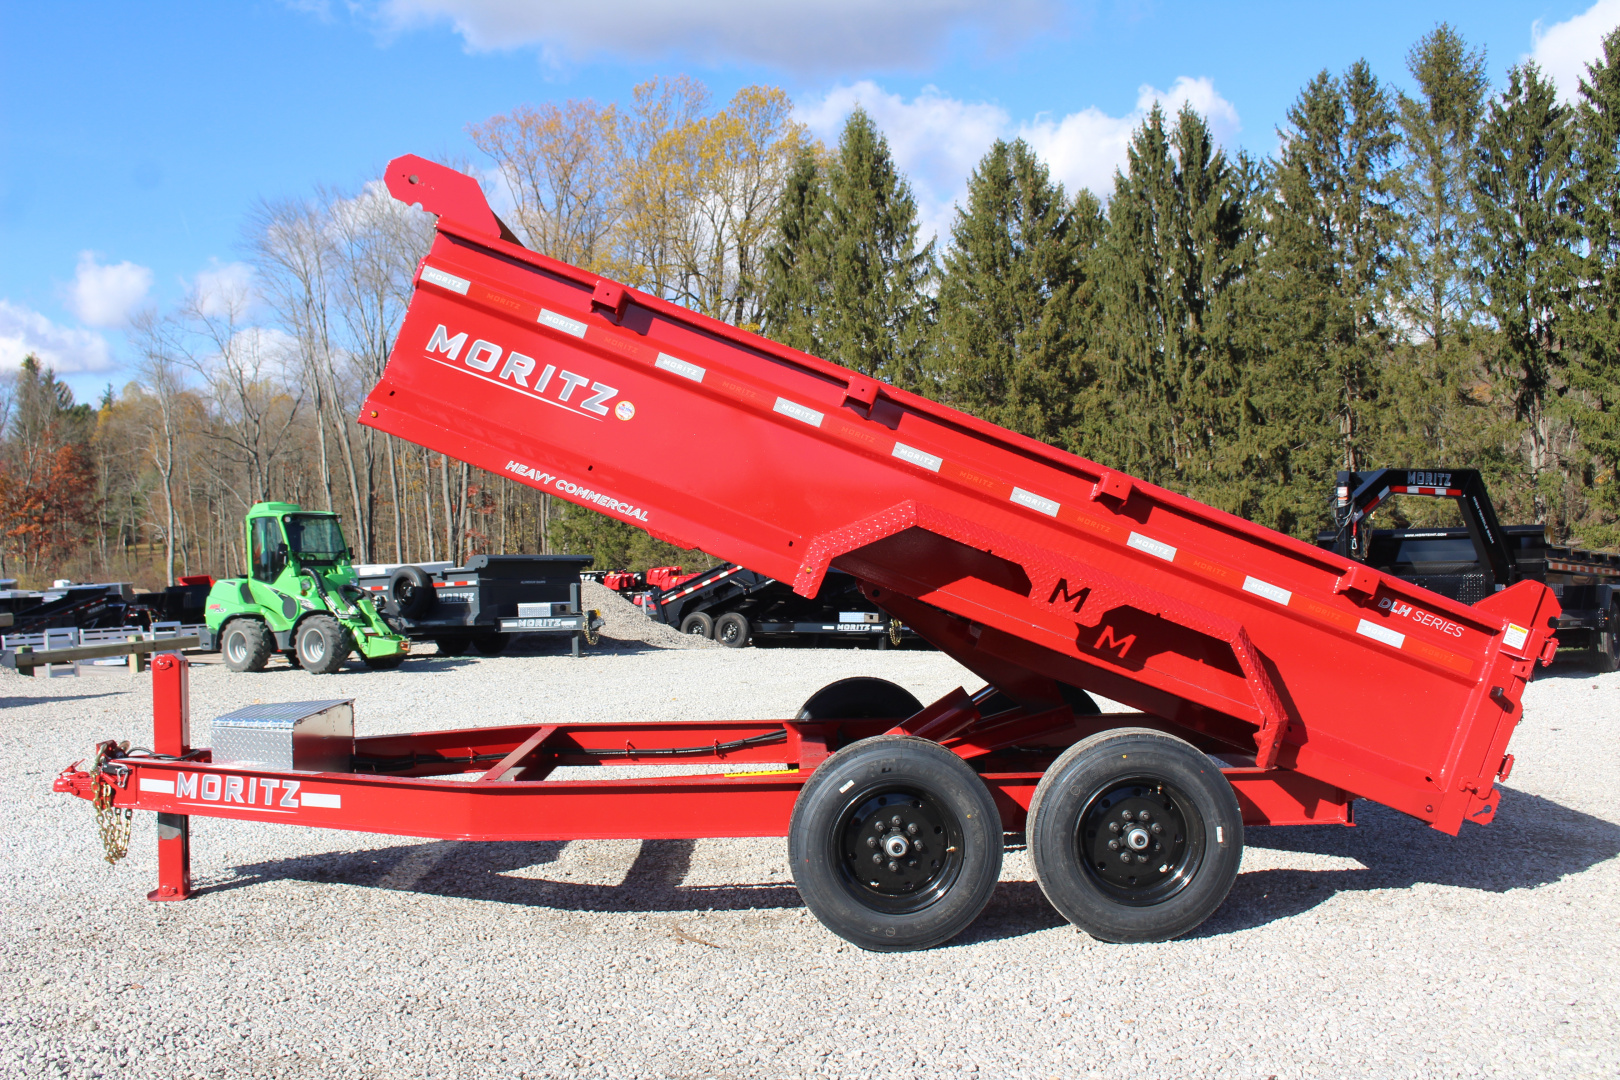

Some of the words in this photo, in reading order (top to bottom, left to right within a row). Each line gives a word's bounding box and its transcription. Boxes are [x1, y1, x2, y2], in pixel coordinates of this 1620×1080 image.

[428, 272, 462, 288] MORITZ
[545, 314, 580, 332] MORITZ
[425, 323, 619, 416] MORITZ
[663, 358, 698, 376] MORITZ
[781, 403, 816, 421] MORITZ
[900, 448, 935, 466] MORITZ
[1407, 471, 1452, 486] MORITZ
[505, 460, 556, 484] HEAVY
[555, 480, 648, 522] COMMERCIAL
[1018, 493, 1052, 510] MORITZ
[1135, 538, 1170, 555] MORITZ
[438, 592, 474, 602] MORITZ
[1250, 582, 1284, 598] MORITZ
[517, 619, 562, 627] MORITZ
[1378, 597, 1412, 617] DLH
[1412, 610, 1465, 638] SERIES
[1364, 625, 1398, 642] MORITZ
[176, 772, 300, 808] MORITZ
